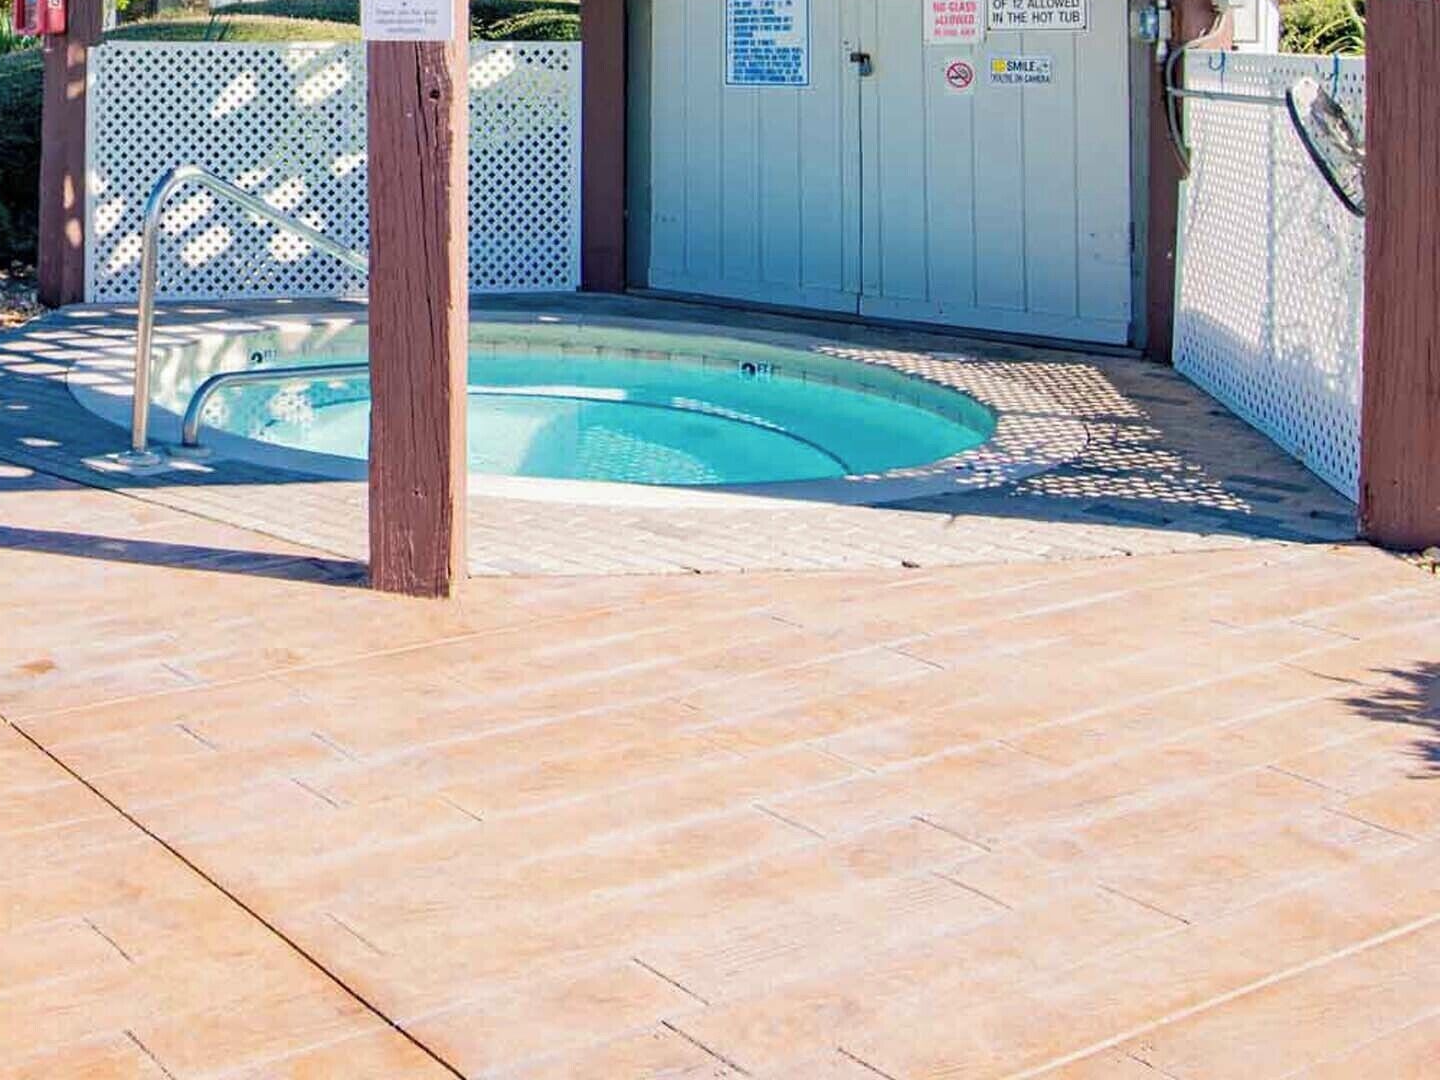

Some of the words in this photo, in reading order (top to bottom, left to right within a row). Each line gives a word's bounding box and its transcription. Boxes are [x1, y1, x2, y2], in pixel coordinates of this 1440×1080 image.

[992, 12, 1003, 23] IN
[1008, 12, 1027, 23] THE
[1032, 11, 1053, 23] HOT
[1058, 11, 1080, 23] TUB
[1007, 60, 1035, 71] SMILE
